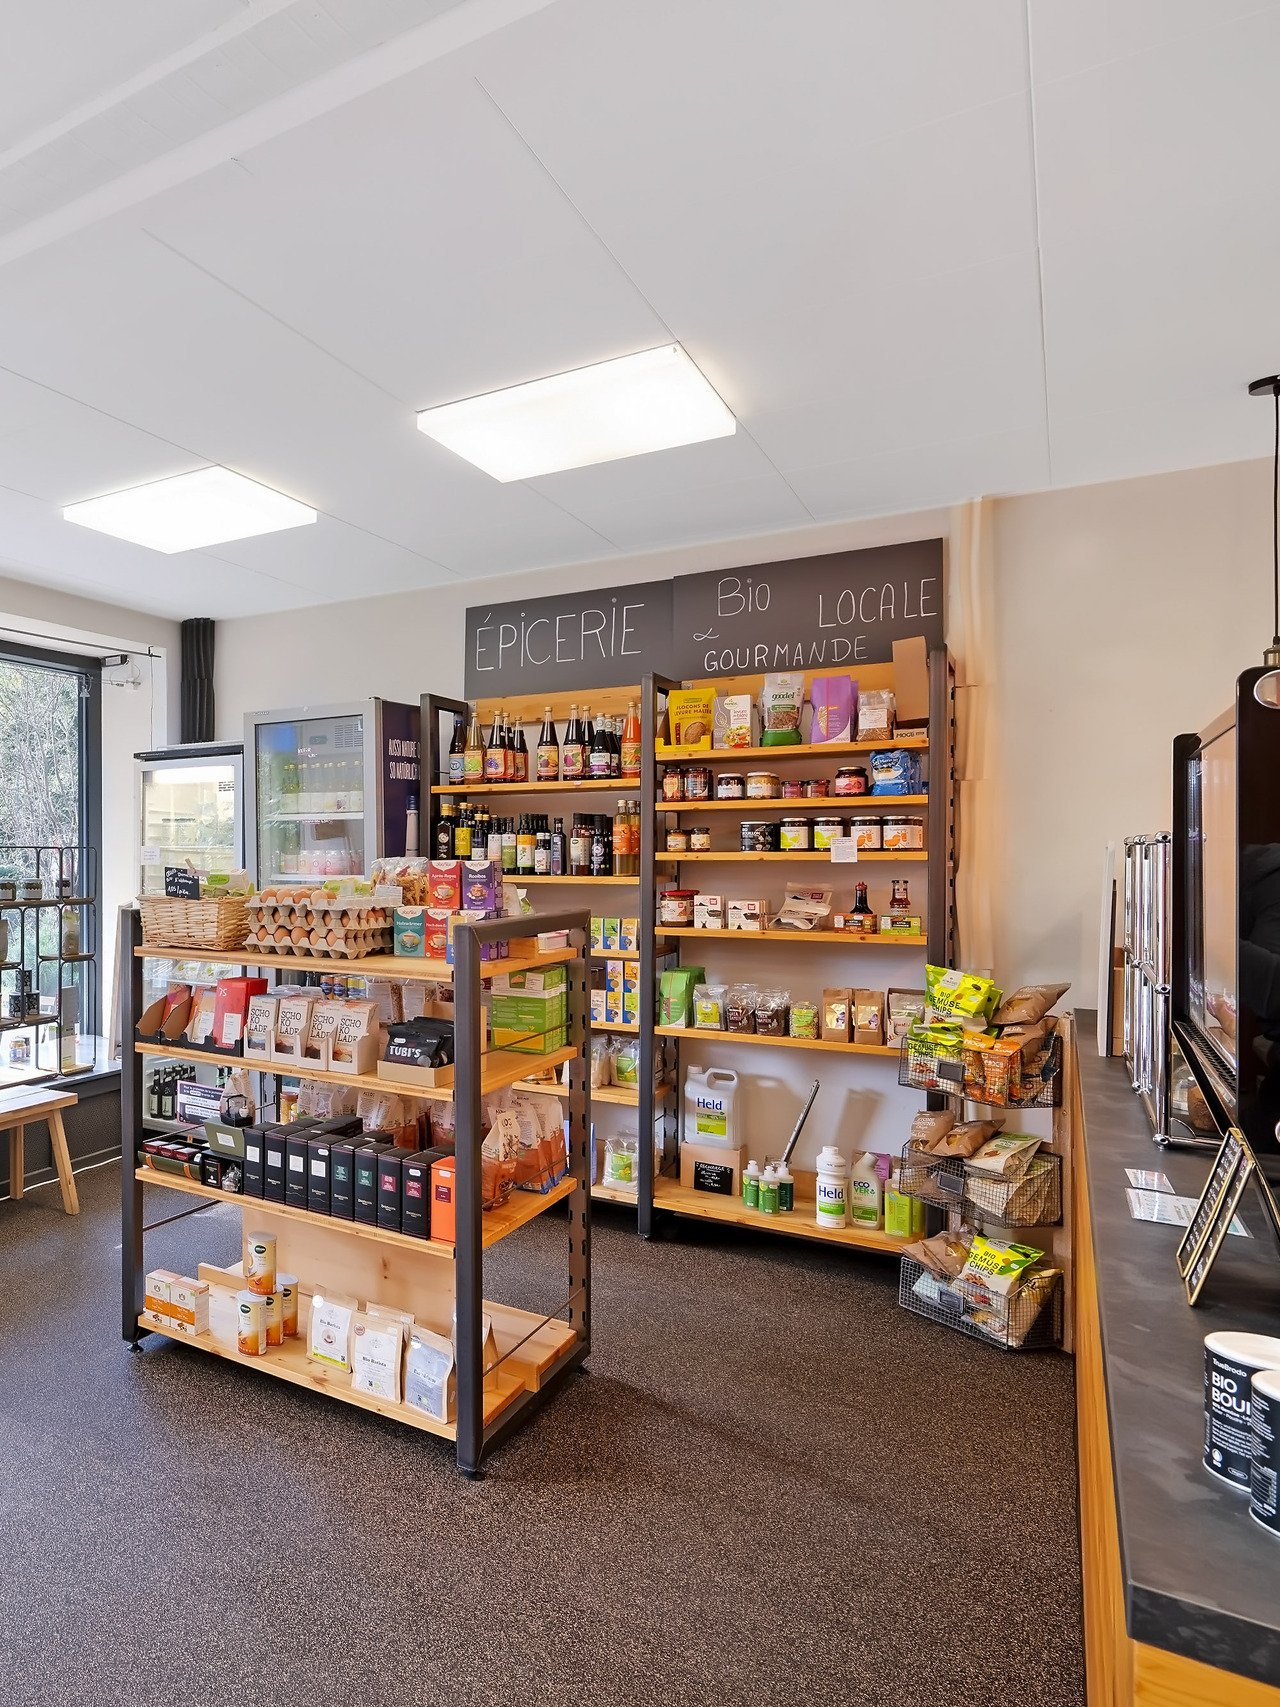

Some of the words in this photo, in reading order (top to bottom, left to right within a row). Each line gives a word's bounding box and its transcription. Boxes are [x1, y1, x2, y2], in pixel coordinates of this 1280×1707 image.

[718, 576, 771, 617] Bio
[818, 577, 937, 628] LOCALE
[704, 635, 869, 672] GOURMANDE
[251, 1008, 270, 1018] SCHO
[280, 1010, 302, 1020] SCHO
[280, 1019, 291, 1027] KO
[312, 1014, 334, 1025] SCHO
[340, 1017, 362, 1028] SCHO
[312, 1023, 323, 1031] KO
[339, 1026, 350, 1034] KO
[389, 1045, 422, 1058] TUBI'S
[697, 1097, 723, 1111] Held
[818, 1184, 844, 1199] Held
[983, 1250, 997, 1260] BIO
[969, 1260, 995, 1276] CHIPS
[1212, 1357, 1248, 1378] TrueBrodo
[1211, 1371, 1238, 1393] BIO
